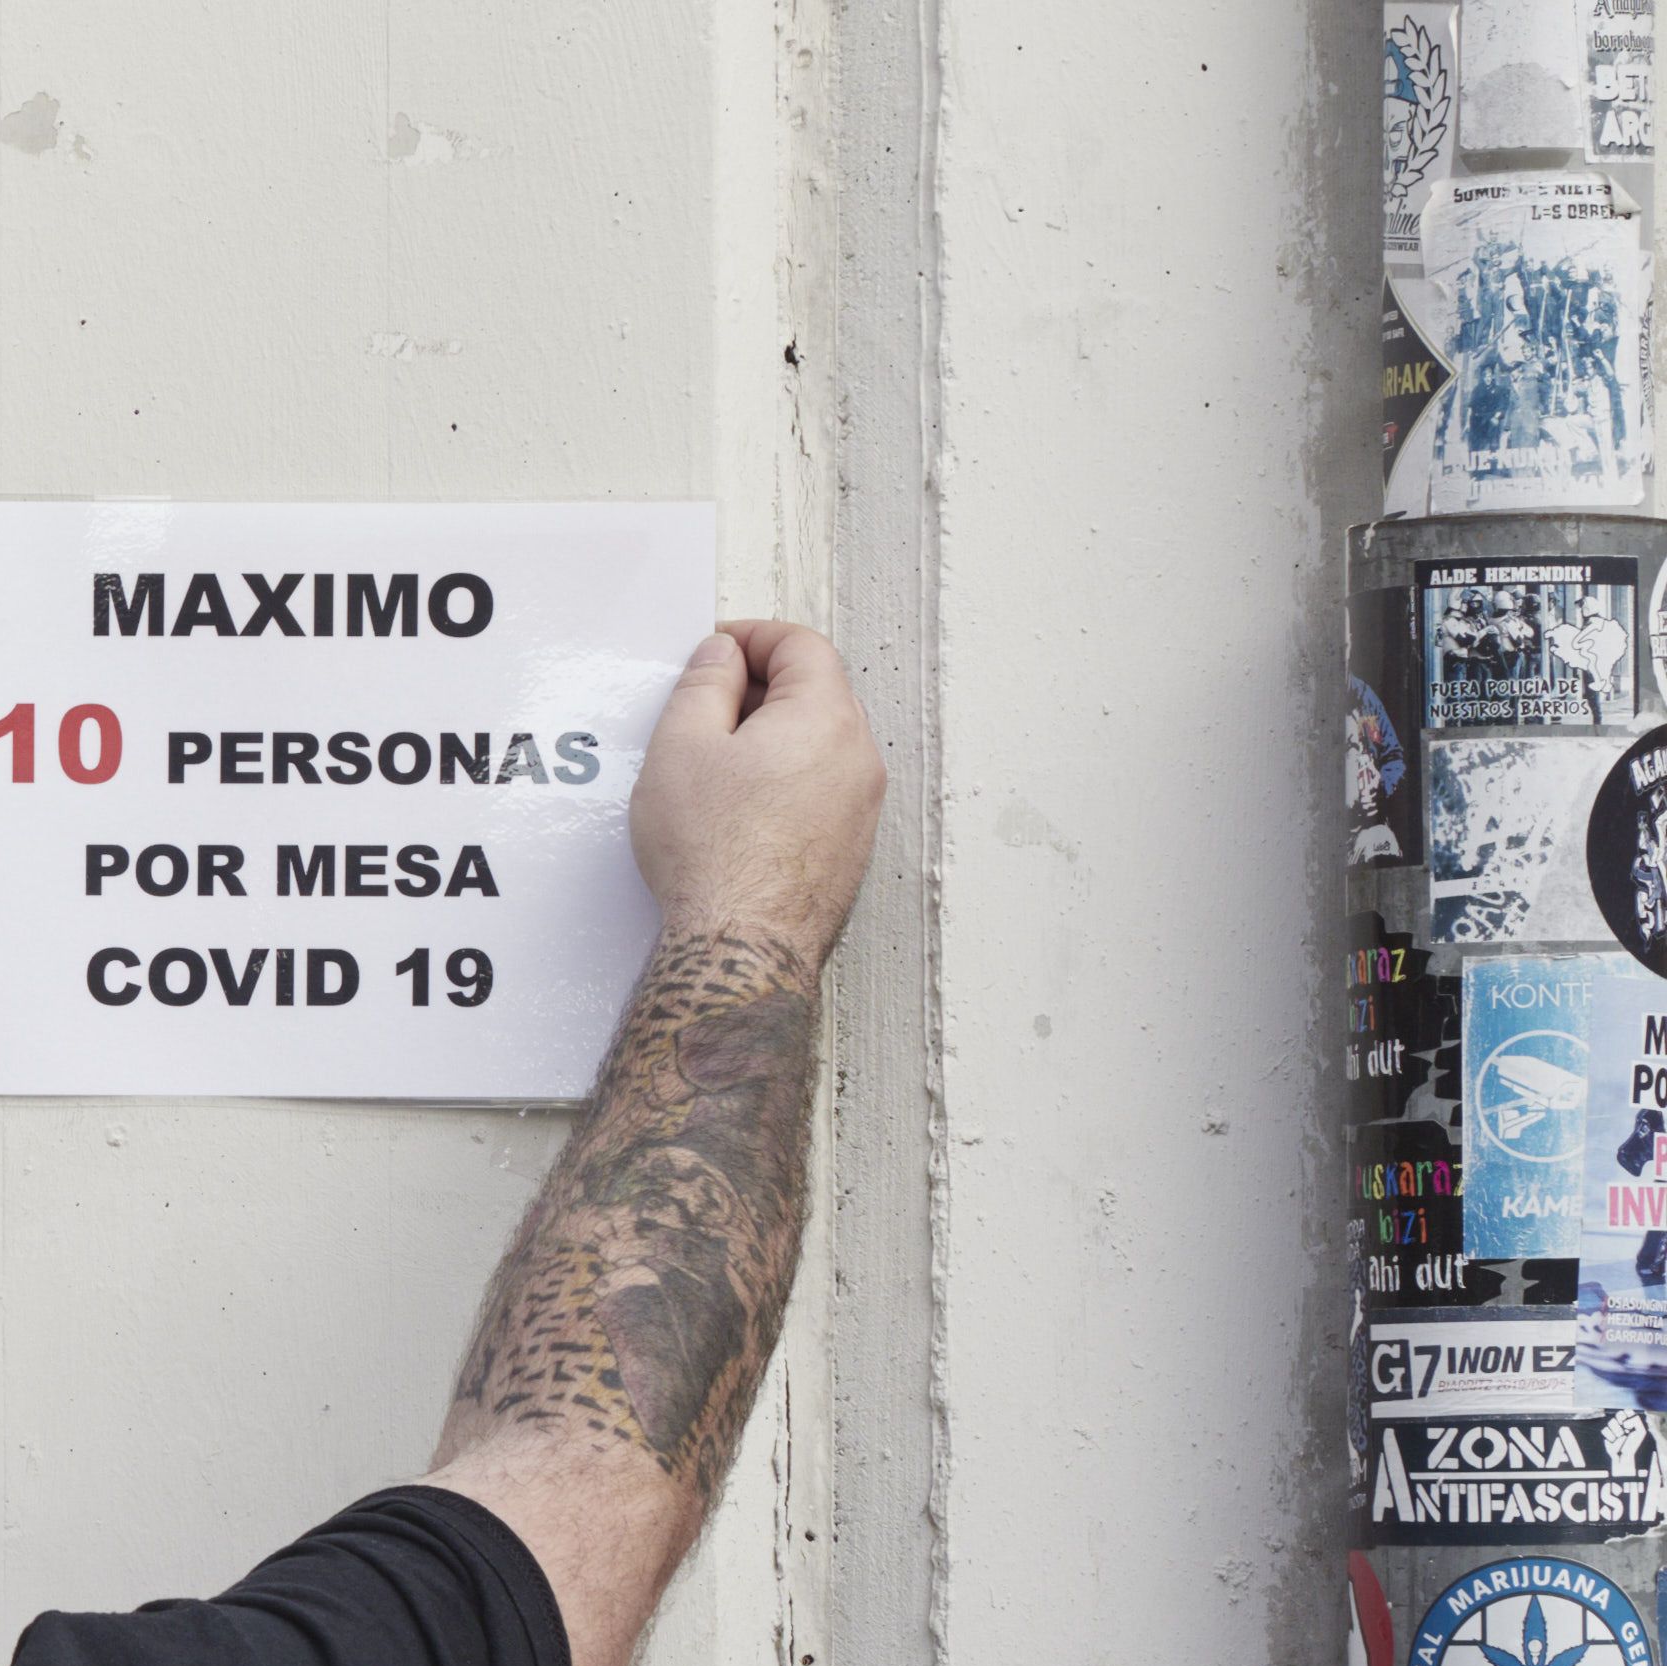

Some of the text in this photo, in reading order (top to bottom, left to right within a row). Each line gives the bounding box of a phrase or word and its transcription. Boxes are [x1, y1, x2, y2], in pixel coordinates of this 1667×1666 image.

[1429, 565, 1592, 586] ALDE HEMENDIK!
[92, 572, 495, 638] MAXIMO
[1429, 680, 1479, 698] FUERA
[1558, 680, 1579, 695] DE
[1429, 698, 1591, 718] NUESTROS BARRIOS
[166, 731, 600, 786] PERSONAS
[85, 844, 500, 899] POR MESA
[85, 947, 494, 1007] COVID 19
[1367, 1038, 1406, 1079] dut
[1379, 1208, 1429, 1246] bizi
[1426, 1426, 1586, 1470] ZONA
[1372, 1427, 1665, 1523] ANTIFASCISTA
[1446, 1565, 1612, 1617] MARIJUANA
